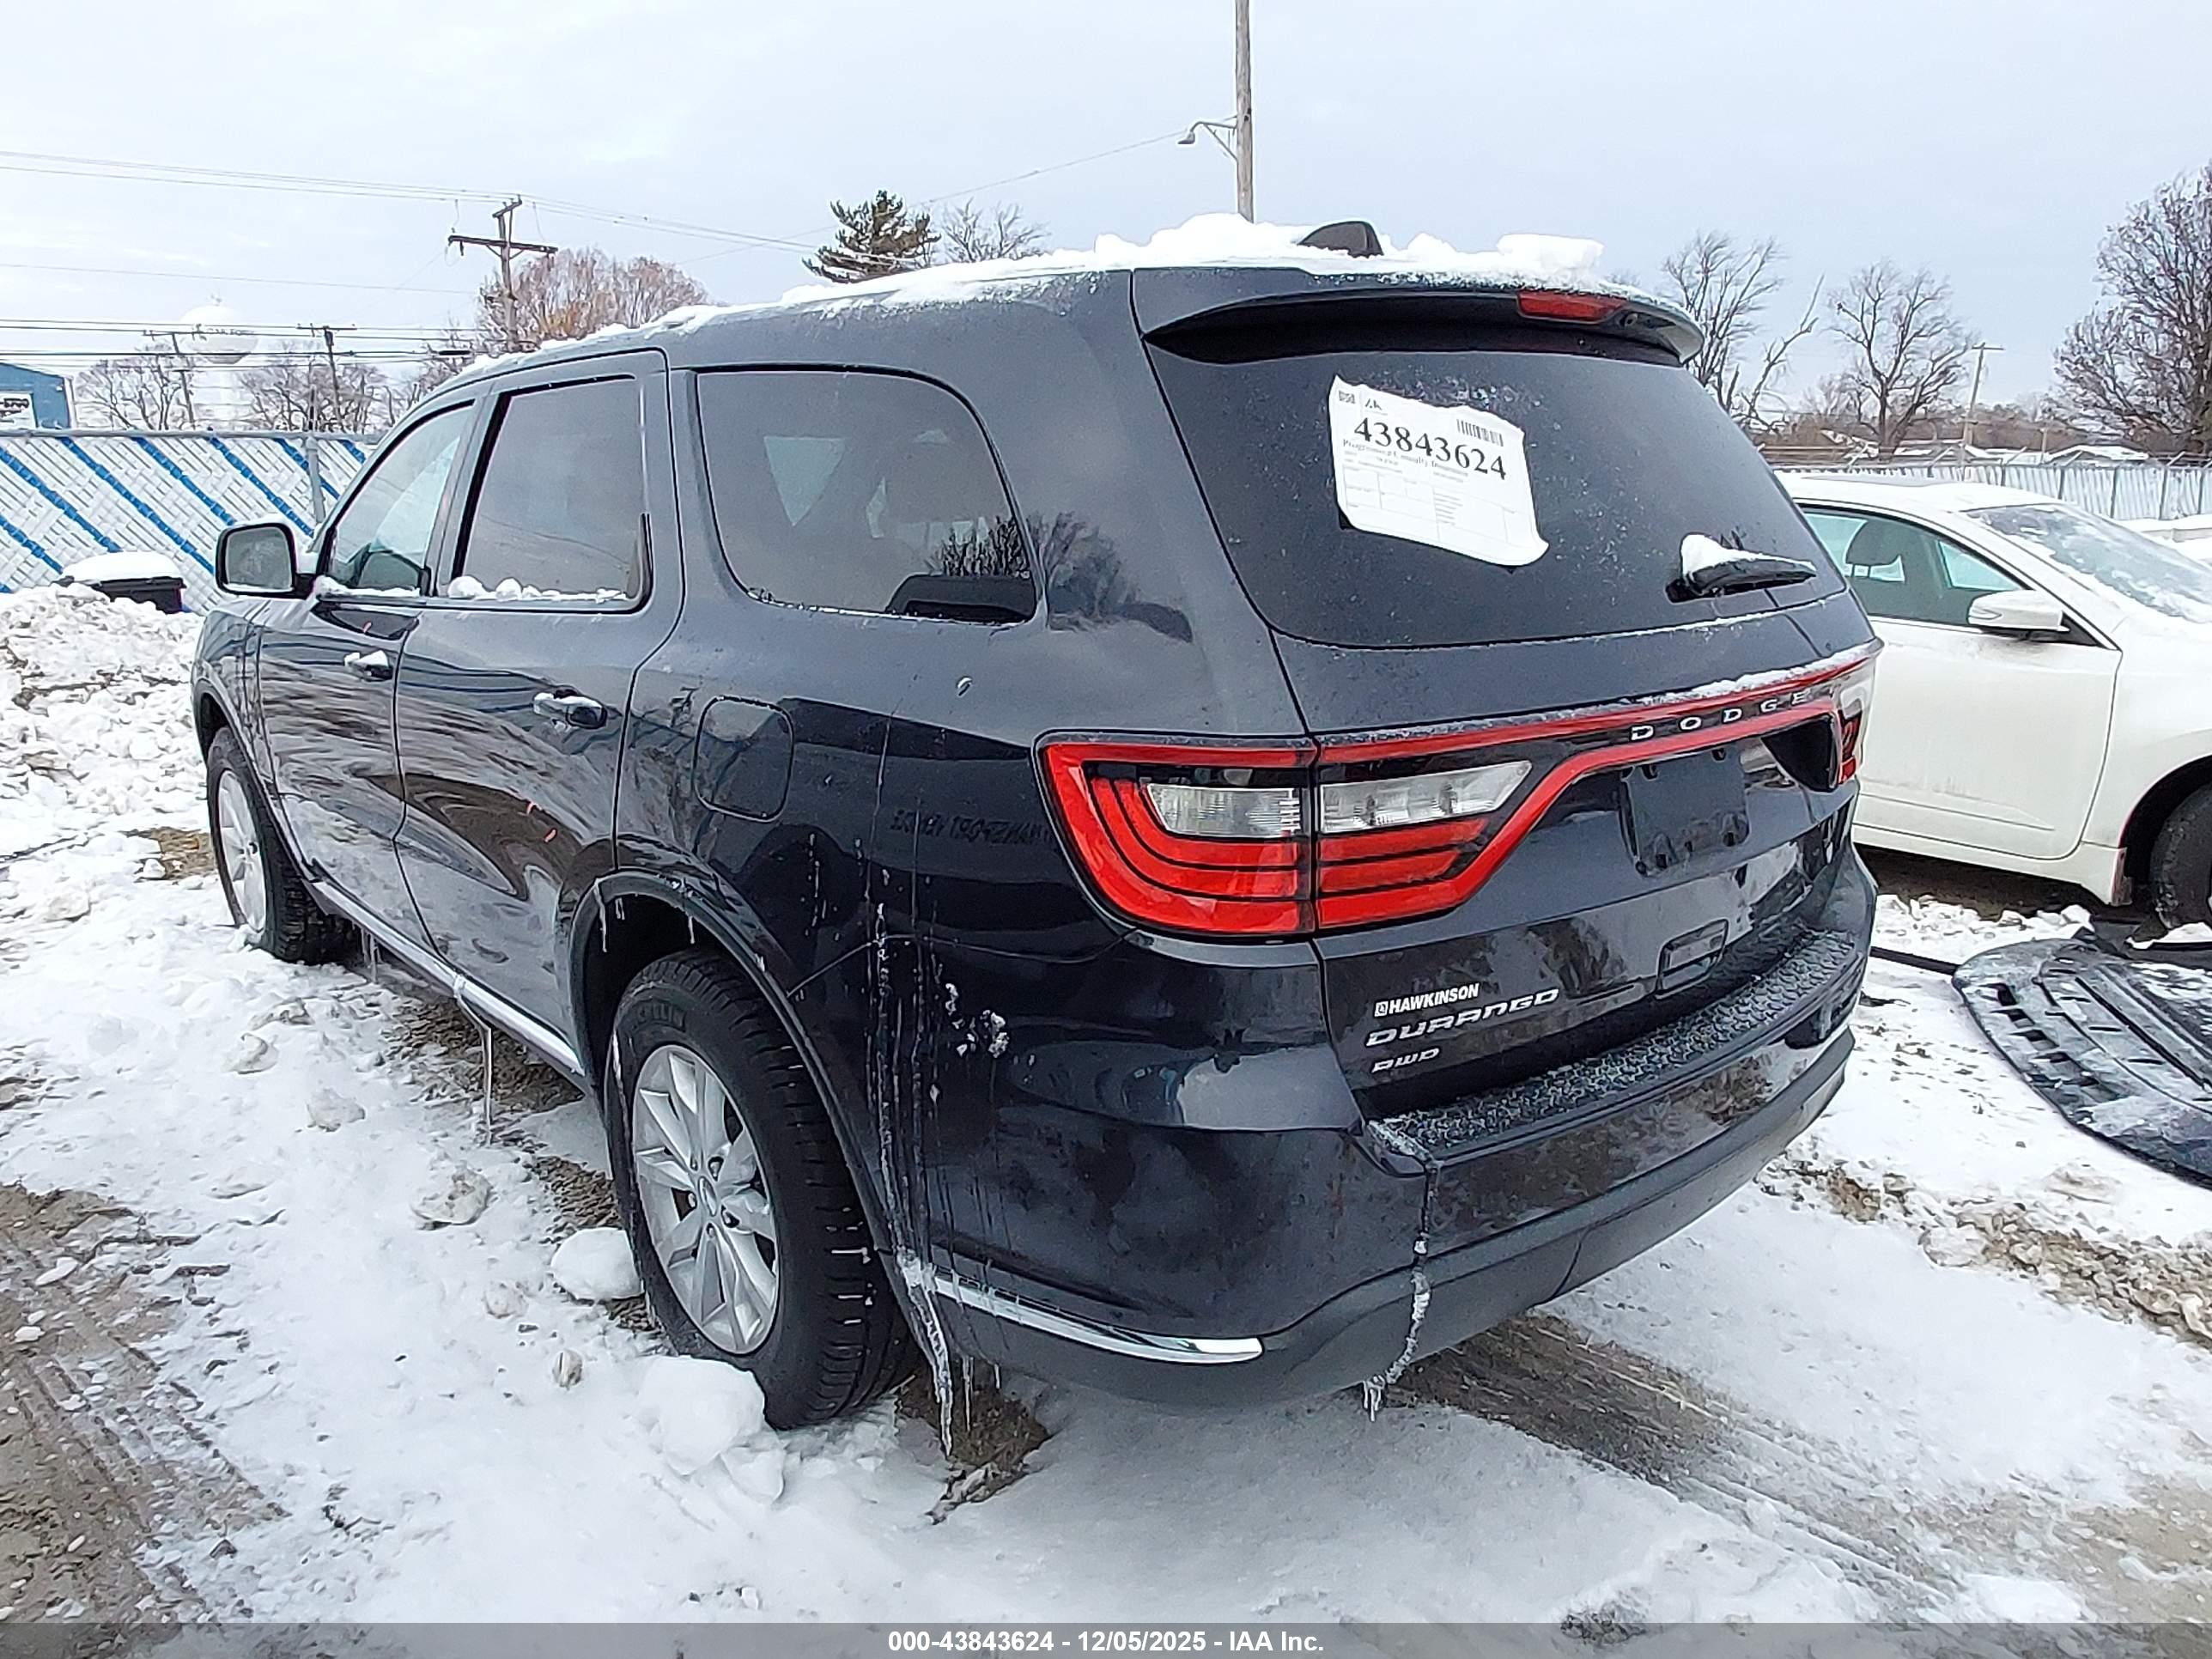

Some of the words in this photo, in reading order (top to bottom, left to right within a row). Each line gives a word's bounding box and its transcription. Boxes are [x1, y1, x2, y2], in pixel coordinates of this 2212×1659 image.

[1354, 417, 1506, 480] 43843624
[1632, 690, 1808, 741] DODGE
[1365, 988, 1559, 1047] DURANGO
[1388, 983, 1480, 1014] HAWKINSON
